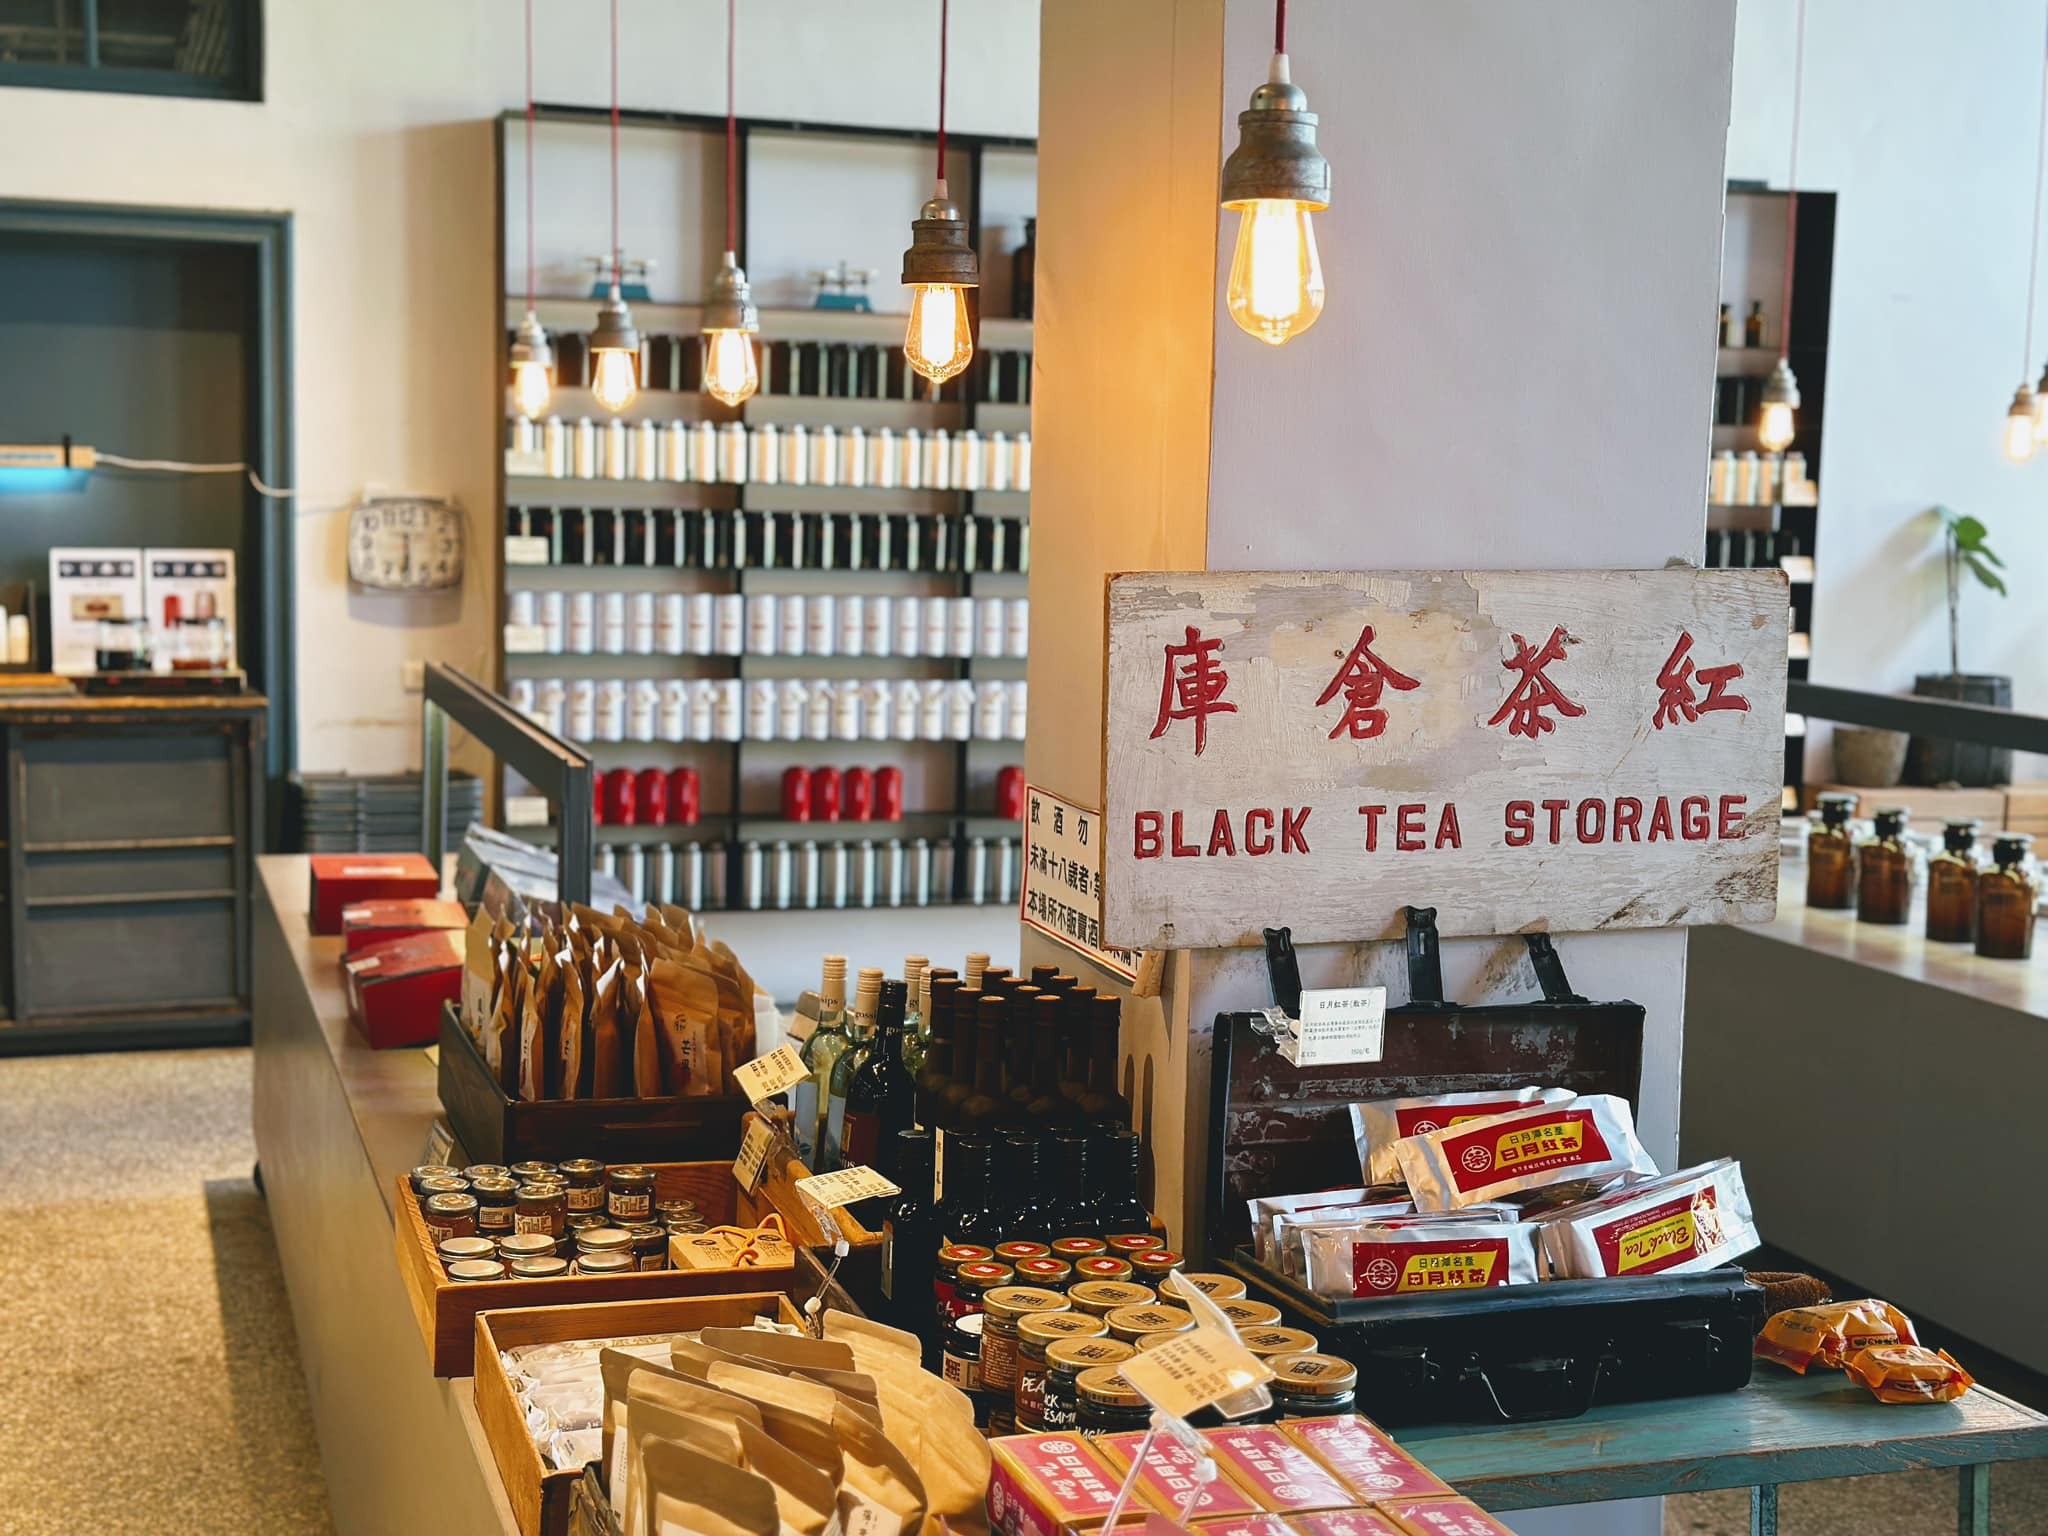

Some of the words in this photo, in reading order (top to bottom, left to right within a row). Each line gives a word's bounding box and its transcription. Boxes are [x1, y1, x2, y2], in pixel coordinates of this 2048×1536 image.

[1133, 805, 1312, 861] BLACK
[1358, 802, 1463, 853] TEA
[1504, 793, 1748, 848] STORAGE
[1623, 1244, 1652, 1258] Tea
[1648, 1226, 1691, 1257] Black
